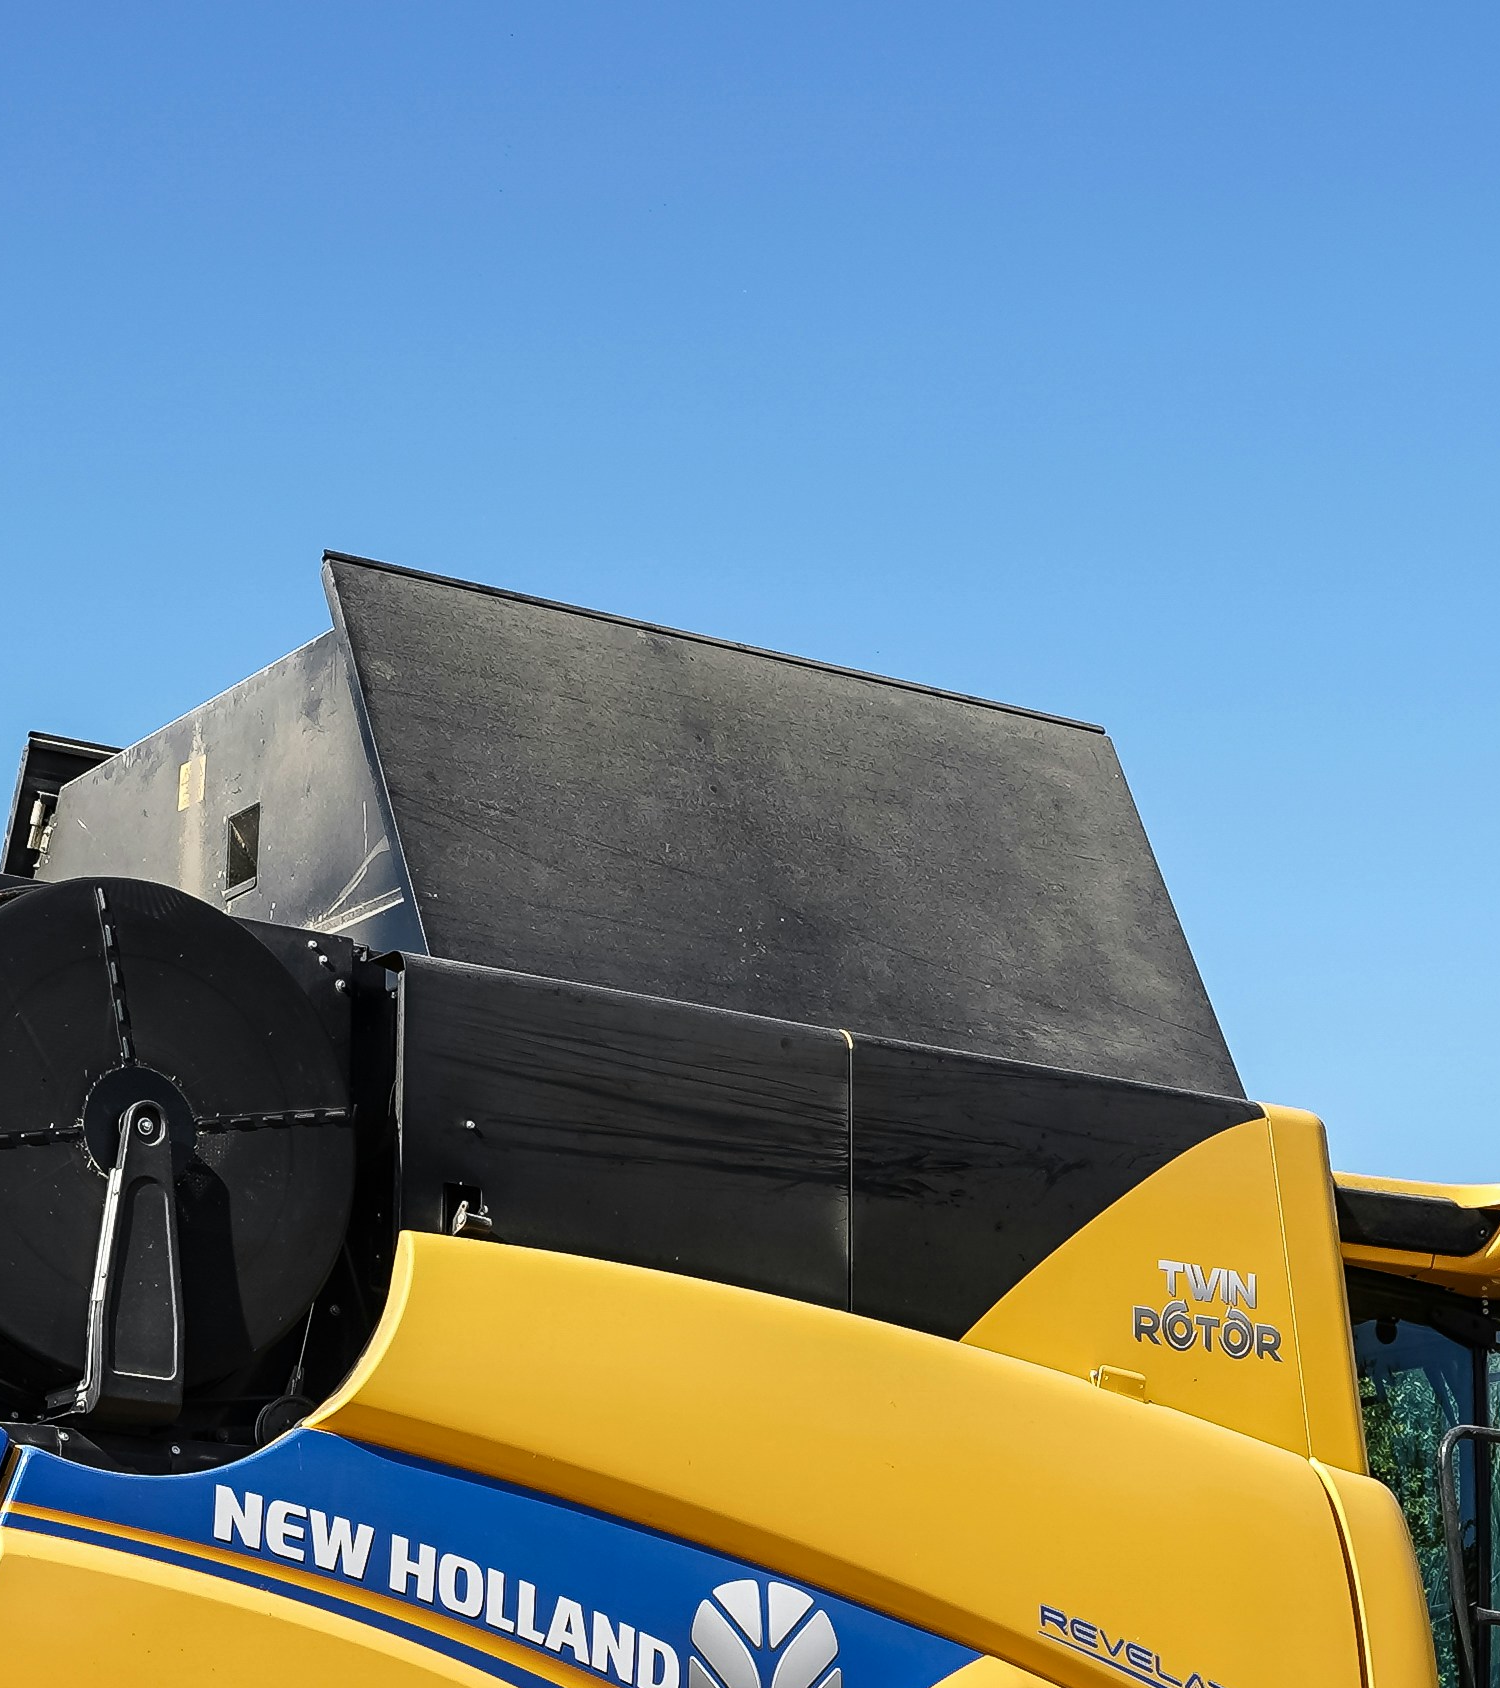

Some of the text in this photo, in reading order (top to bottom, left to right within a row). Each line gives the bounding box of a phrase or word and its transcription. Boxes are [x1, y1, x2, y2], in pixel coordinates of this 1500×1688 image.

[1158, 1260, 1257, 1309] TWIN
[1132, 1299, 1284, 1362] ROTOR
[213, 1484, 375, 1581] NEW
